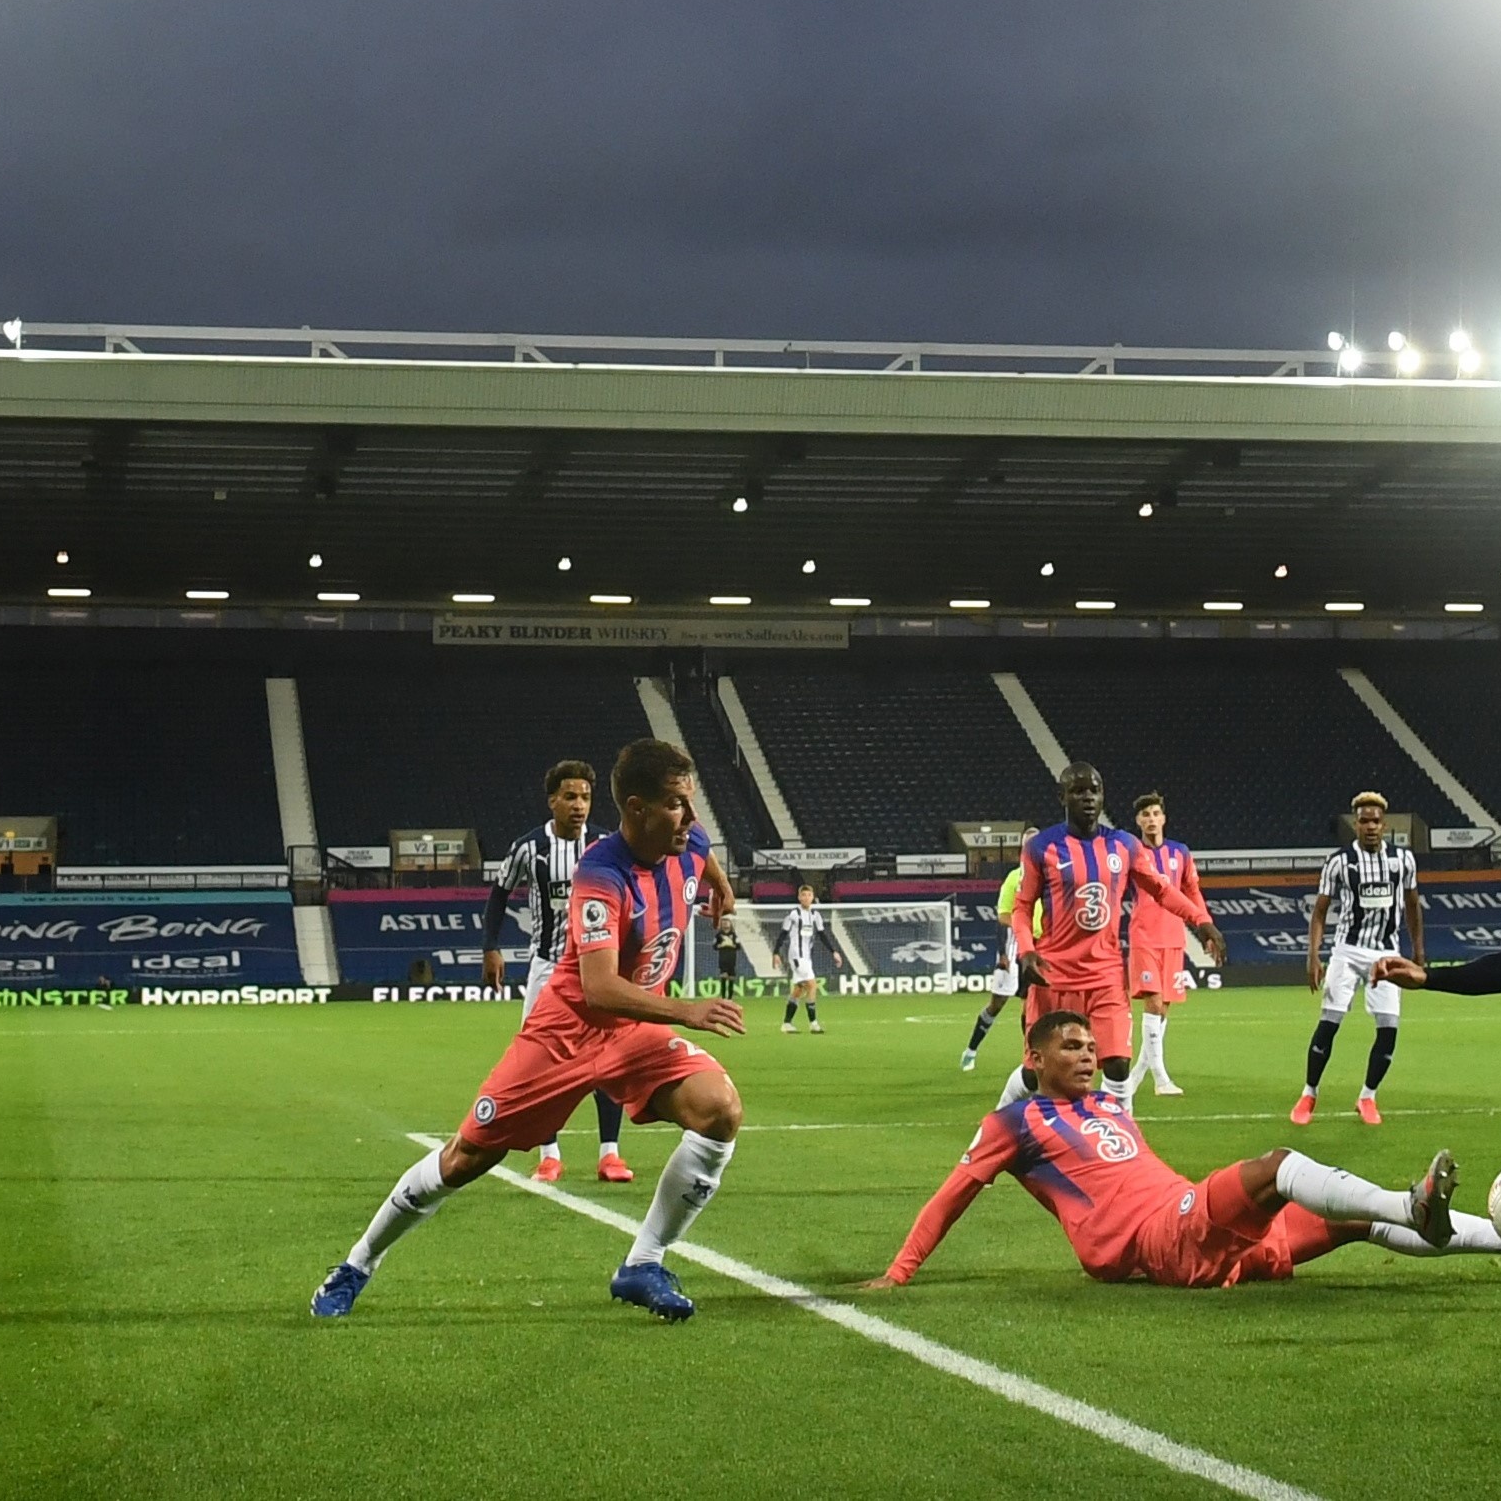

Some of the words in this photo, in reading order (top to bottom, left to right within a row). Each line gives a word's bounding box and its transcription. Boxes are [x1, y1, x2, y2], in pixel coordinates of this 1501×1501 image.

[439, 625, 502, 639] PEAKY
[509, 625, 592, 639] BLINDER
[596, 627, 668, 641] WHISKEY
[413, 842, 428, 852] V2
[1361, 883, 1391, 896] ideal
[1075, 882, 1111, 931] 3
[379, 913, 467, 931] ASTLE
[131, 950, 241, 970] ideal
[1080, 1117, 1138, 1162] 3
